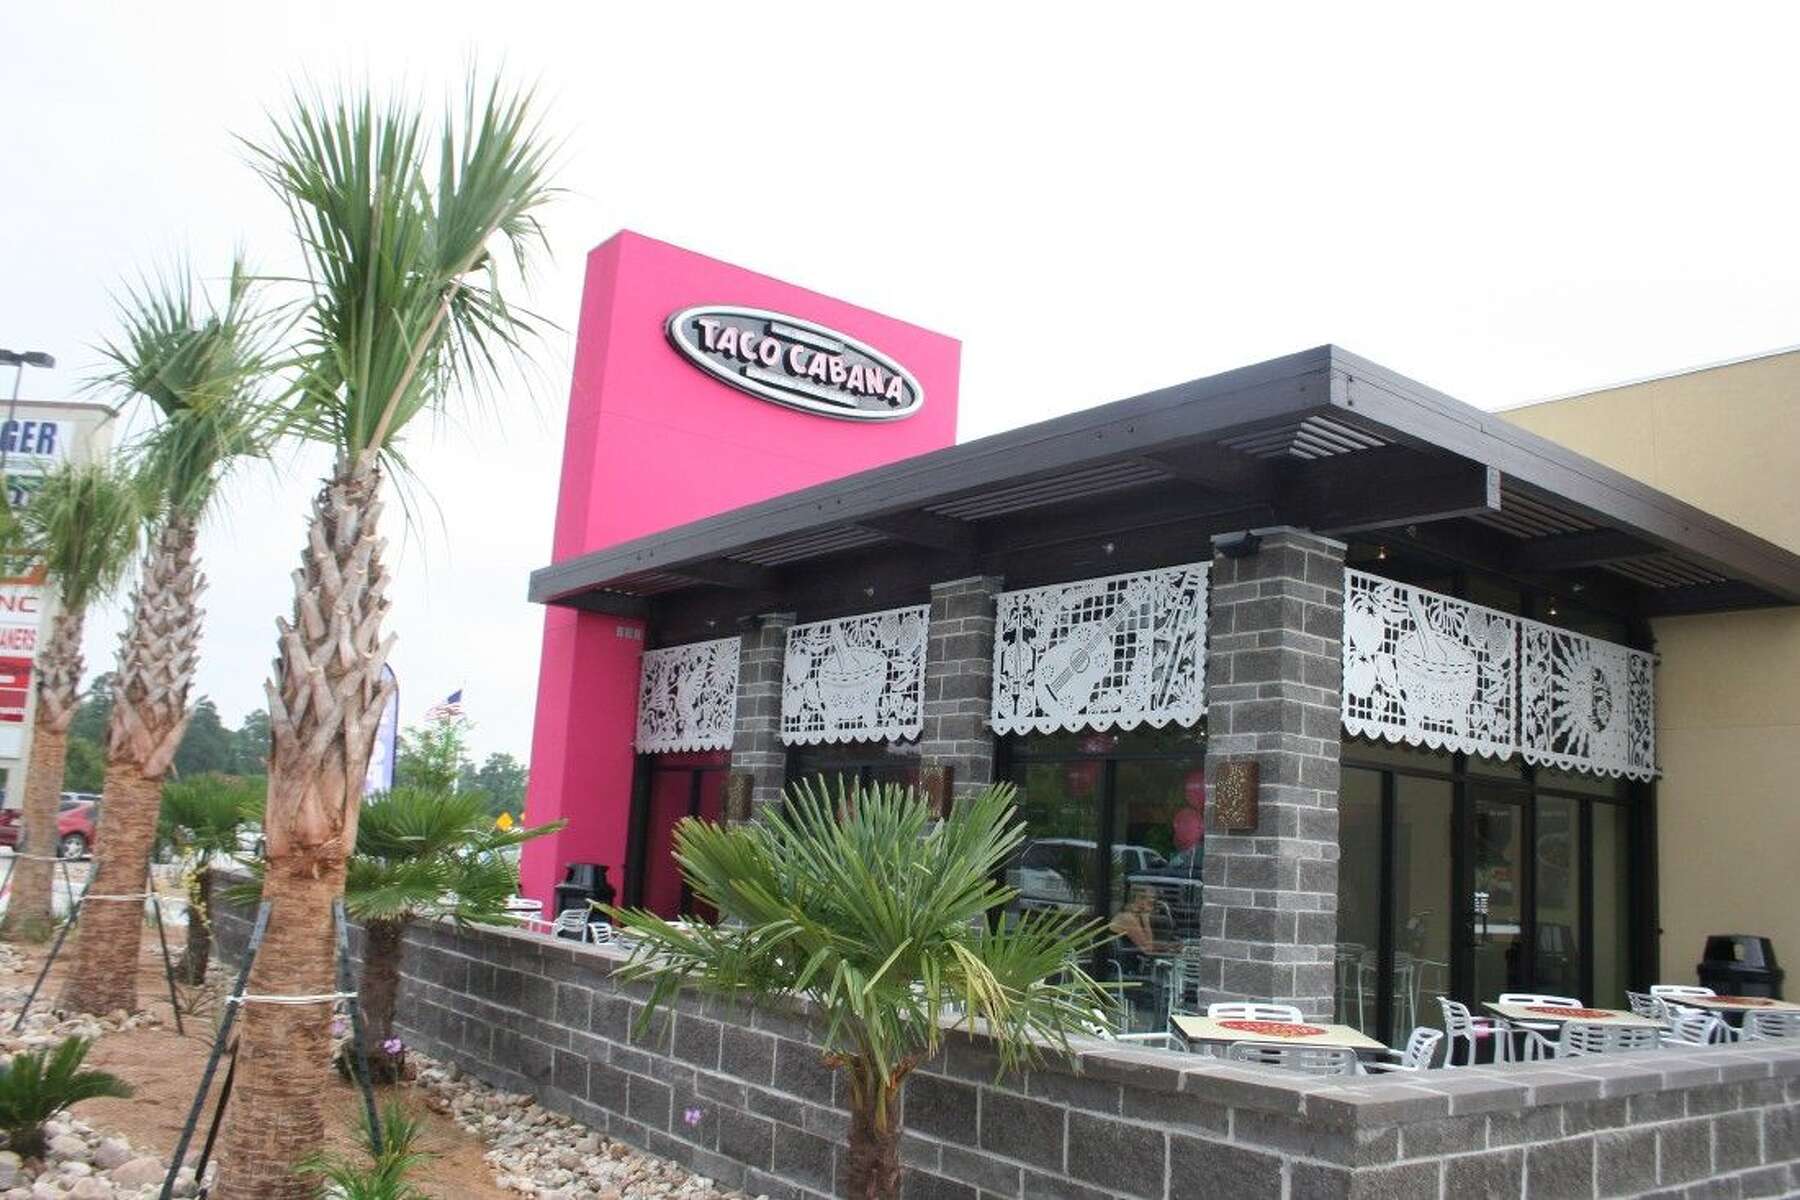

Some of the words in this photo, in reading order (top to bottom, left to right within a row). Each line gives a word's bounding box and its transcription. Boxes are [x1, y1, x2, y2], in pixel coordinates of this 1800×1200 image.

[696, 319, 782, 366] TACO
[786, 343, 903, 404] CABANA
[0, 420, 57, 454] GER
